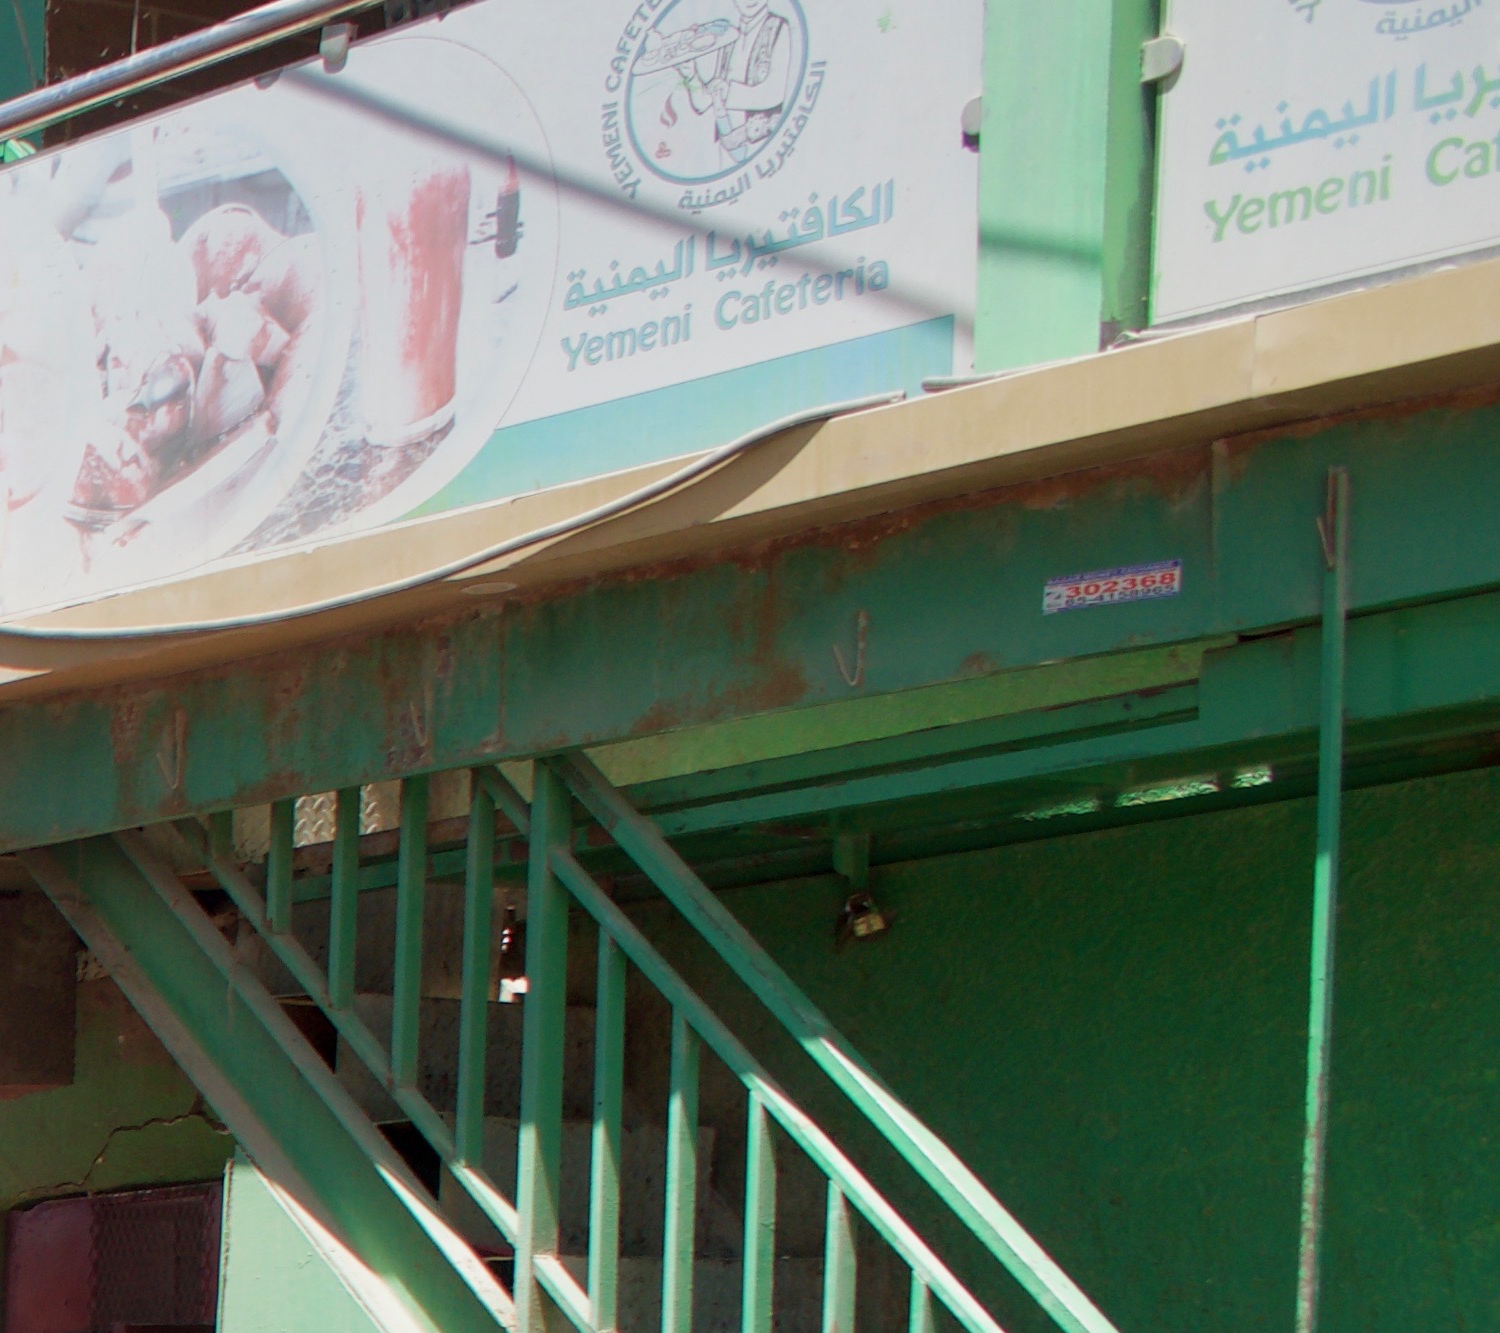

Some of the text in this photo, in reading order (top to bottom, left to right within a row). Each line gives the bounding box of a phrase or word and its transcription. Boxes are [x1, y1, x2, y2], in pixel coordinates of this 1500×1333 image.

[601, 101, 641, 199] YEMENI
[1207, 68, 1397, 174] اليمنية
[678, 173, 751, 214] اليمنية
[1203, 153, 1393, 244] Yemeni
[563, 178, 894, 318] الكافتيريا اليمنية
[560, 255, 890, 372] Yemeni Cafeteria
[1065, 572, 1176, 599] 302368
